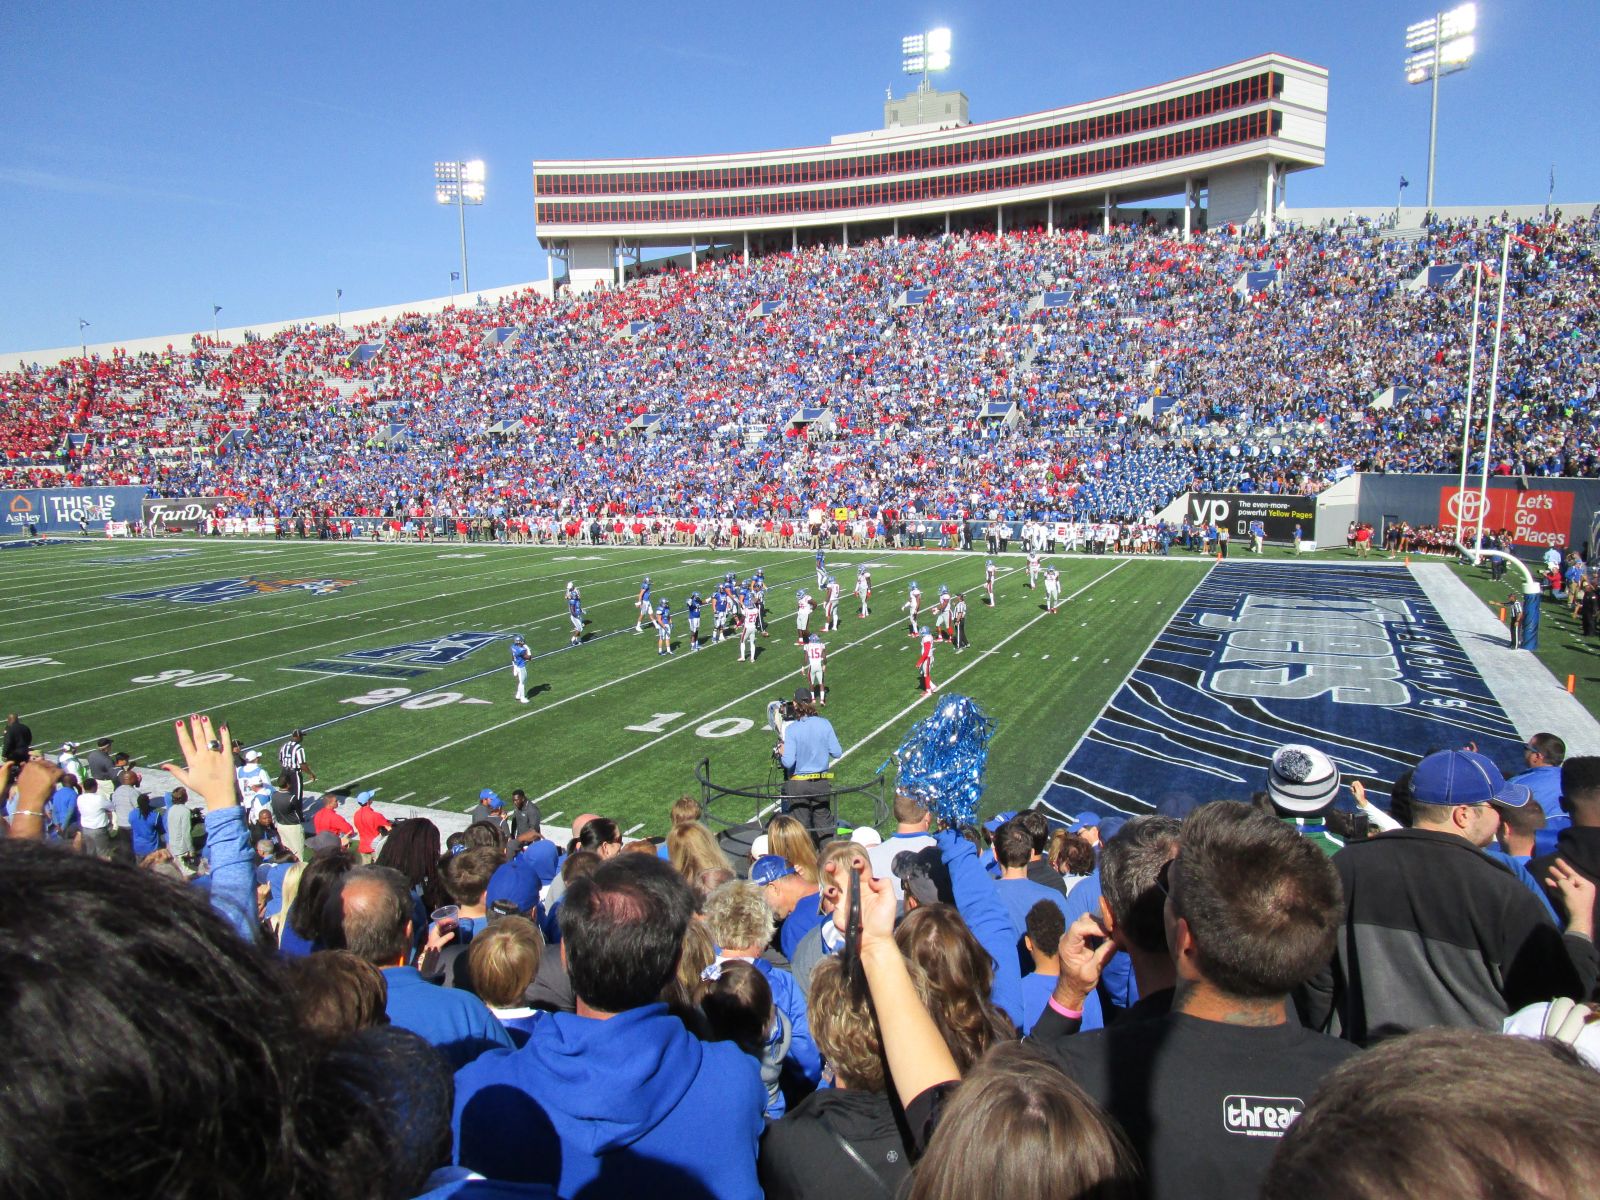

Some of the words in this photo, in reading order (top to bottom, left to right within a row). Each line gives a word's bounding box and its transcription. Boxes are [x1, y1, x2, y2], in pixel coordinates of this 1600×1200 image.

[50, 496, 96, 511] THIS
[99, 495, 116, 508] IS
[1517, 493, 1553, 510] Let's
[5, 512, 41, 523] Ashley
[1192, 499, 1230, 527] yp
[1268, 510, 1290, 518] Yellow
[1291, 511, 1313, 520] Pages
[1514, 510, 1537, 525] Go
[1513, 526, 1566, 545] Places
[811, 647, 820, 659] 15
[131, 669, 235, 688] 30
[339, 686, 464, 711] 20
[624, 711, 755, 738] 10
